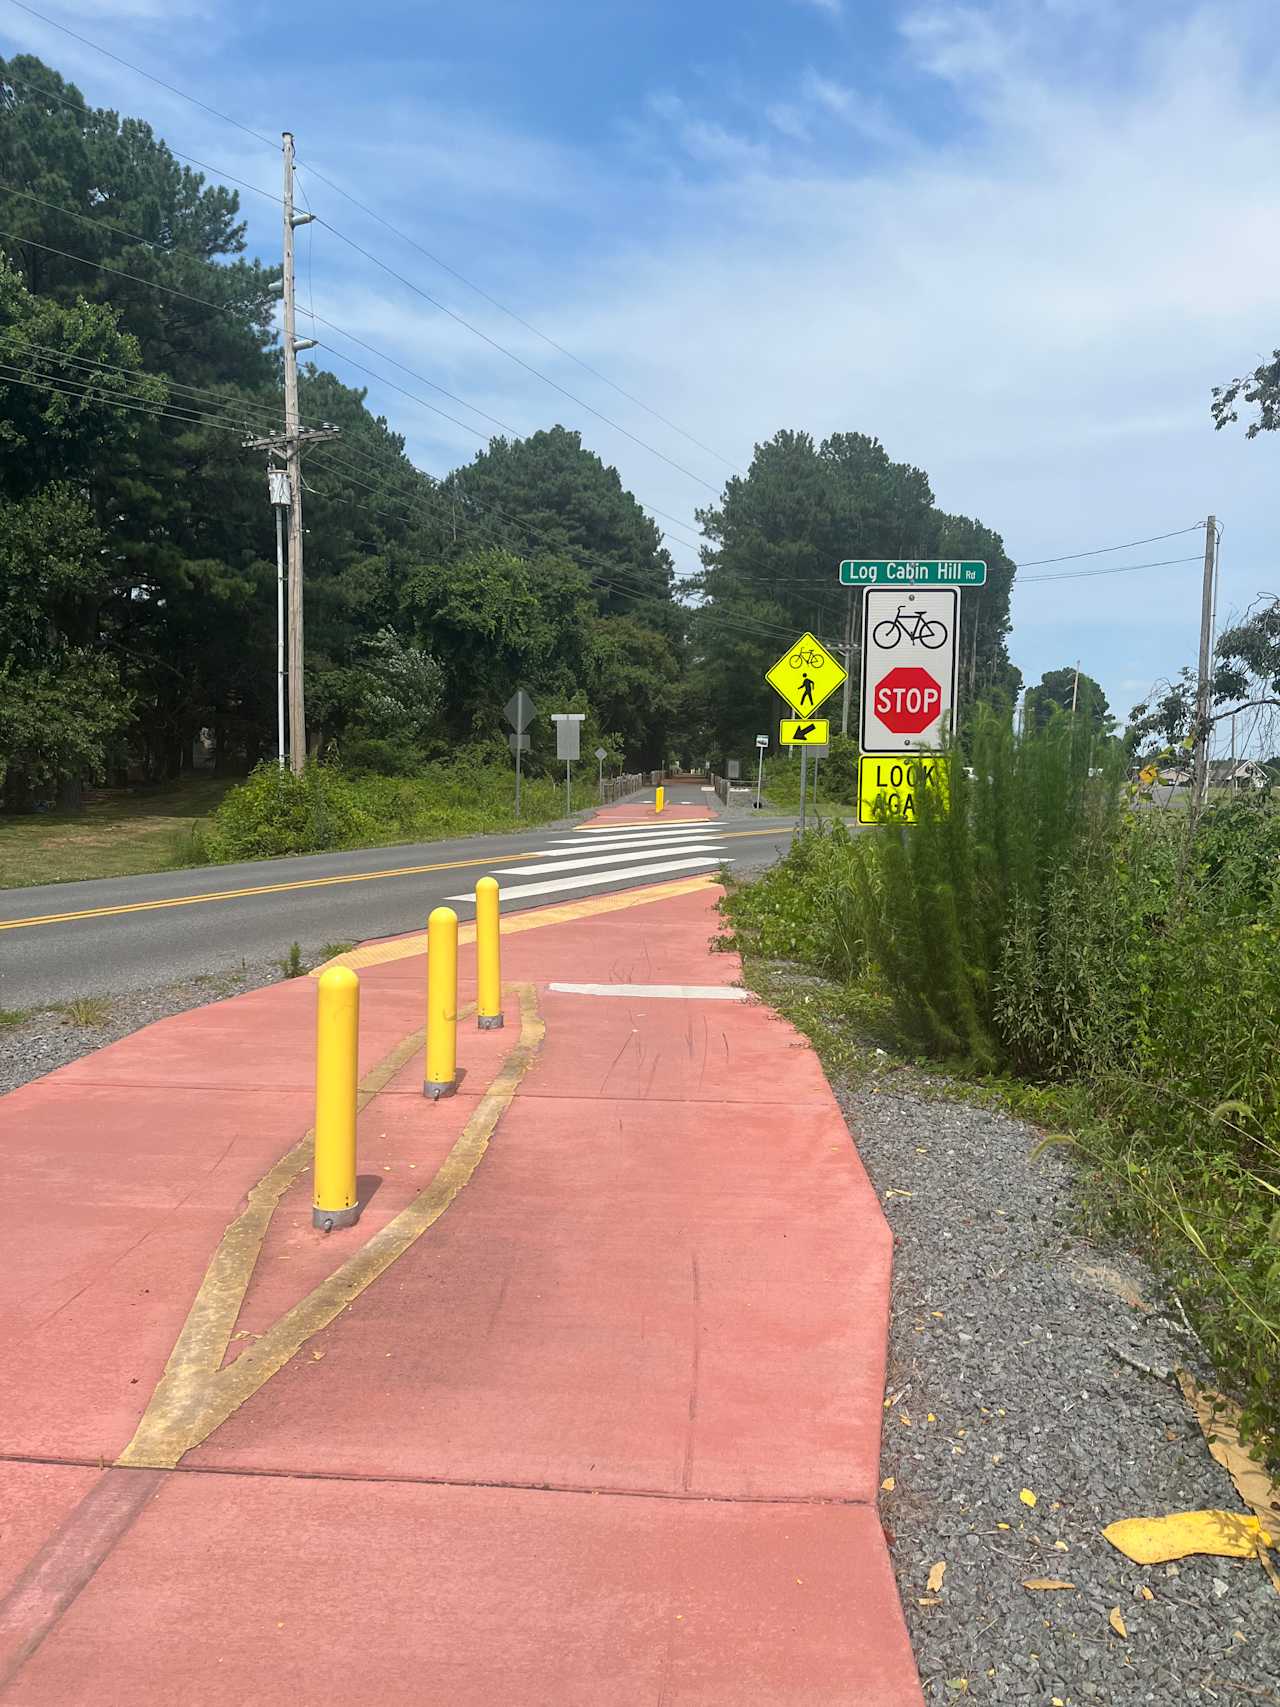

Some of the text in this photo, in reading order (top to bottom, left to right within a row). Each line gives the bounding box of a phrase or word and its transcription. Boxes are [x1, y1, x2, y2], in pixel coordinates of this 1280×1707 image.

[850, 562, 976, 582] Log Cabin Hill Rd
[877, 687, 938, 713] STOP
[872, 793, 918, 816] AGA
